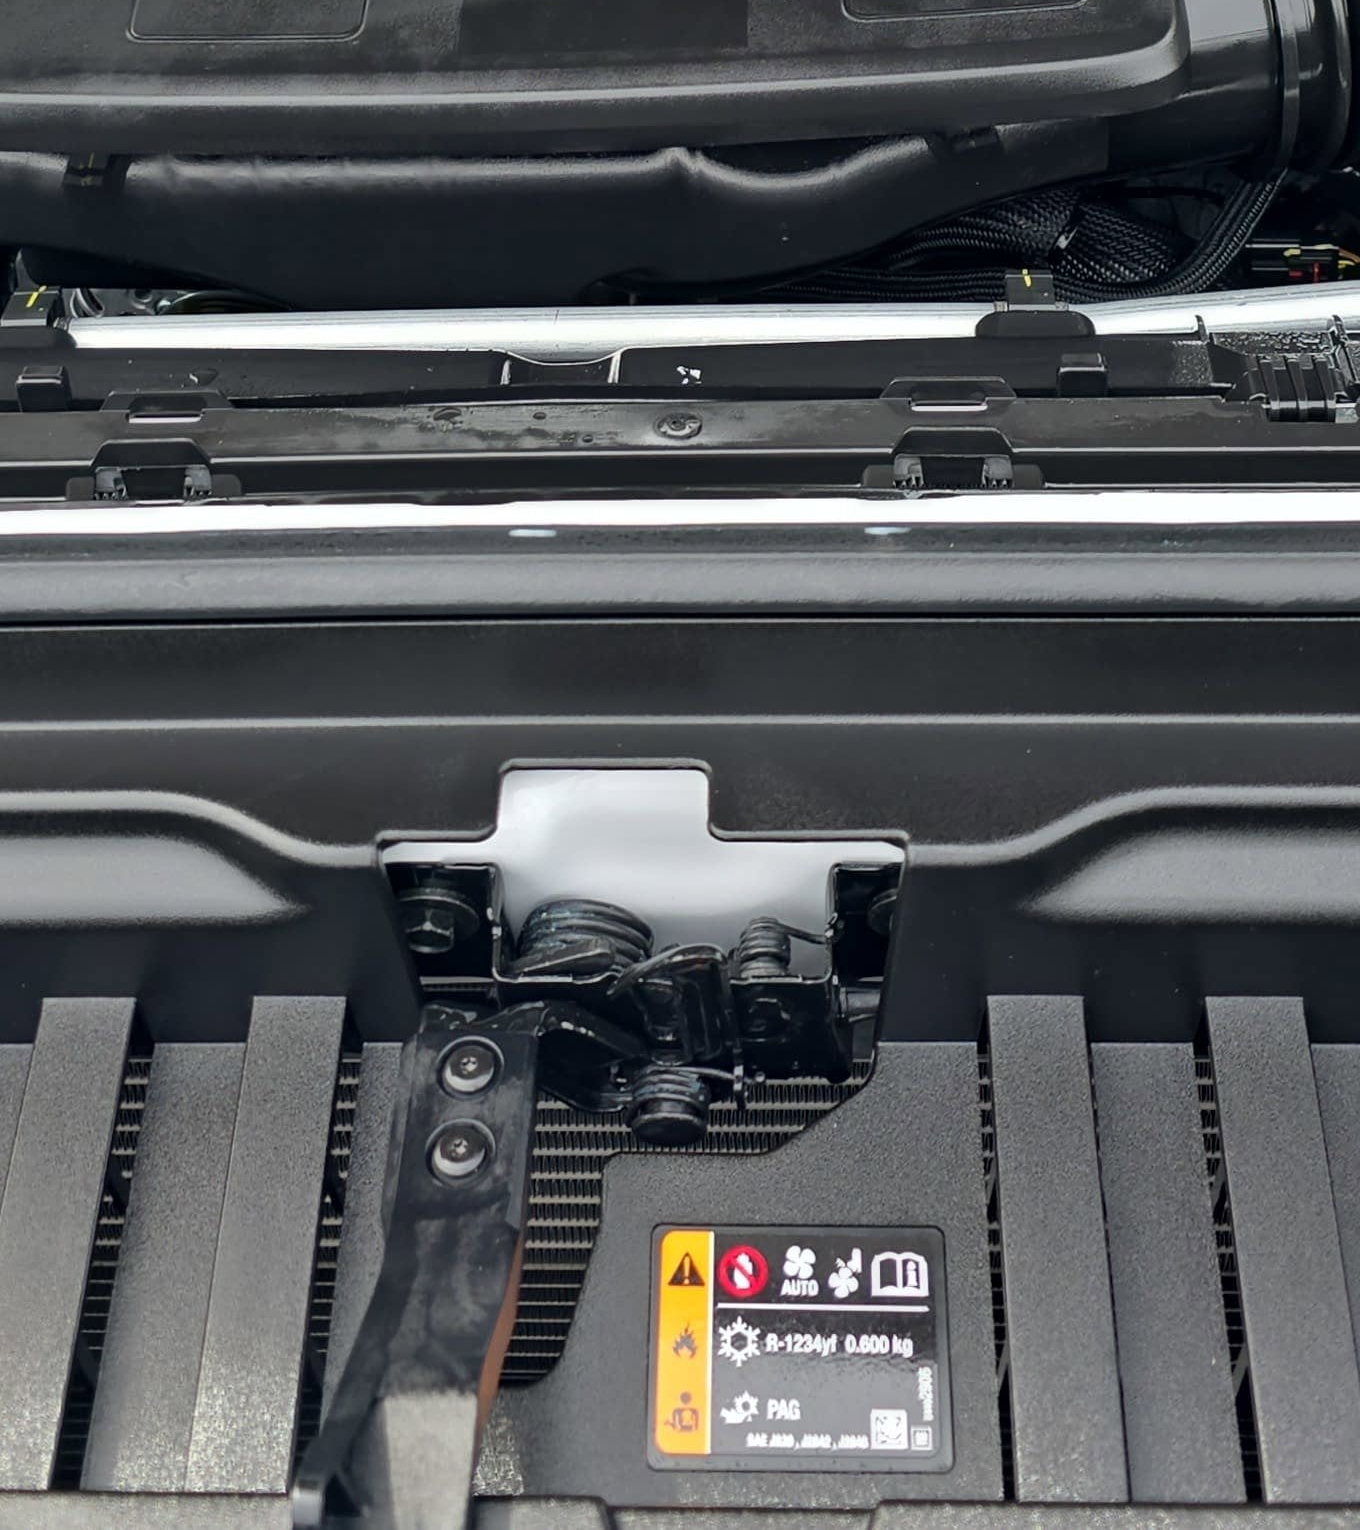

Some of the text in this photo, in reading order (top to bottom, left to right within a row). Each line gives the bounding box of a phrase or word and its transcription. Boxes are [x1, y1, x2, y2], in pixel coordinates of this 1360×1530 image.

[780, 1279, 820, 1297] AUTO
[765, 1333, 838, 1357] R-1234yf
[892, 1334, 914, 1358] kg
[767, 1399, 801, 1420] PAG
